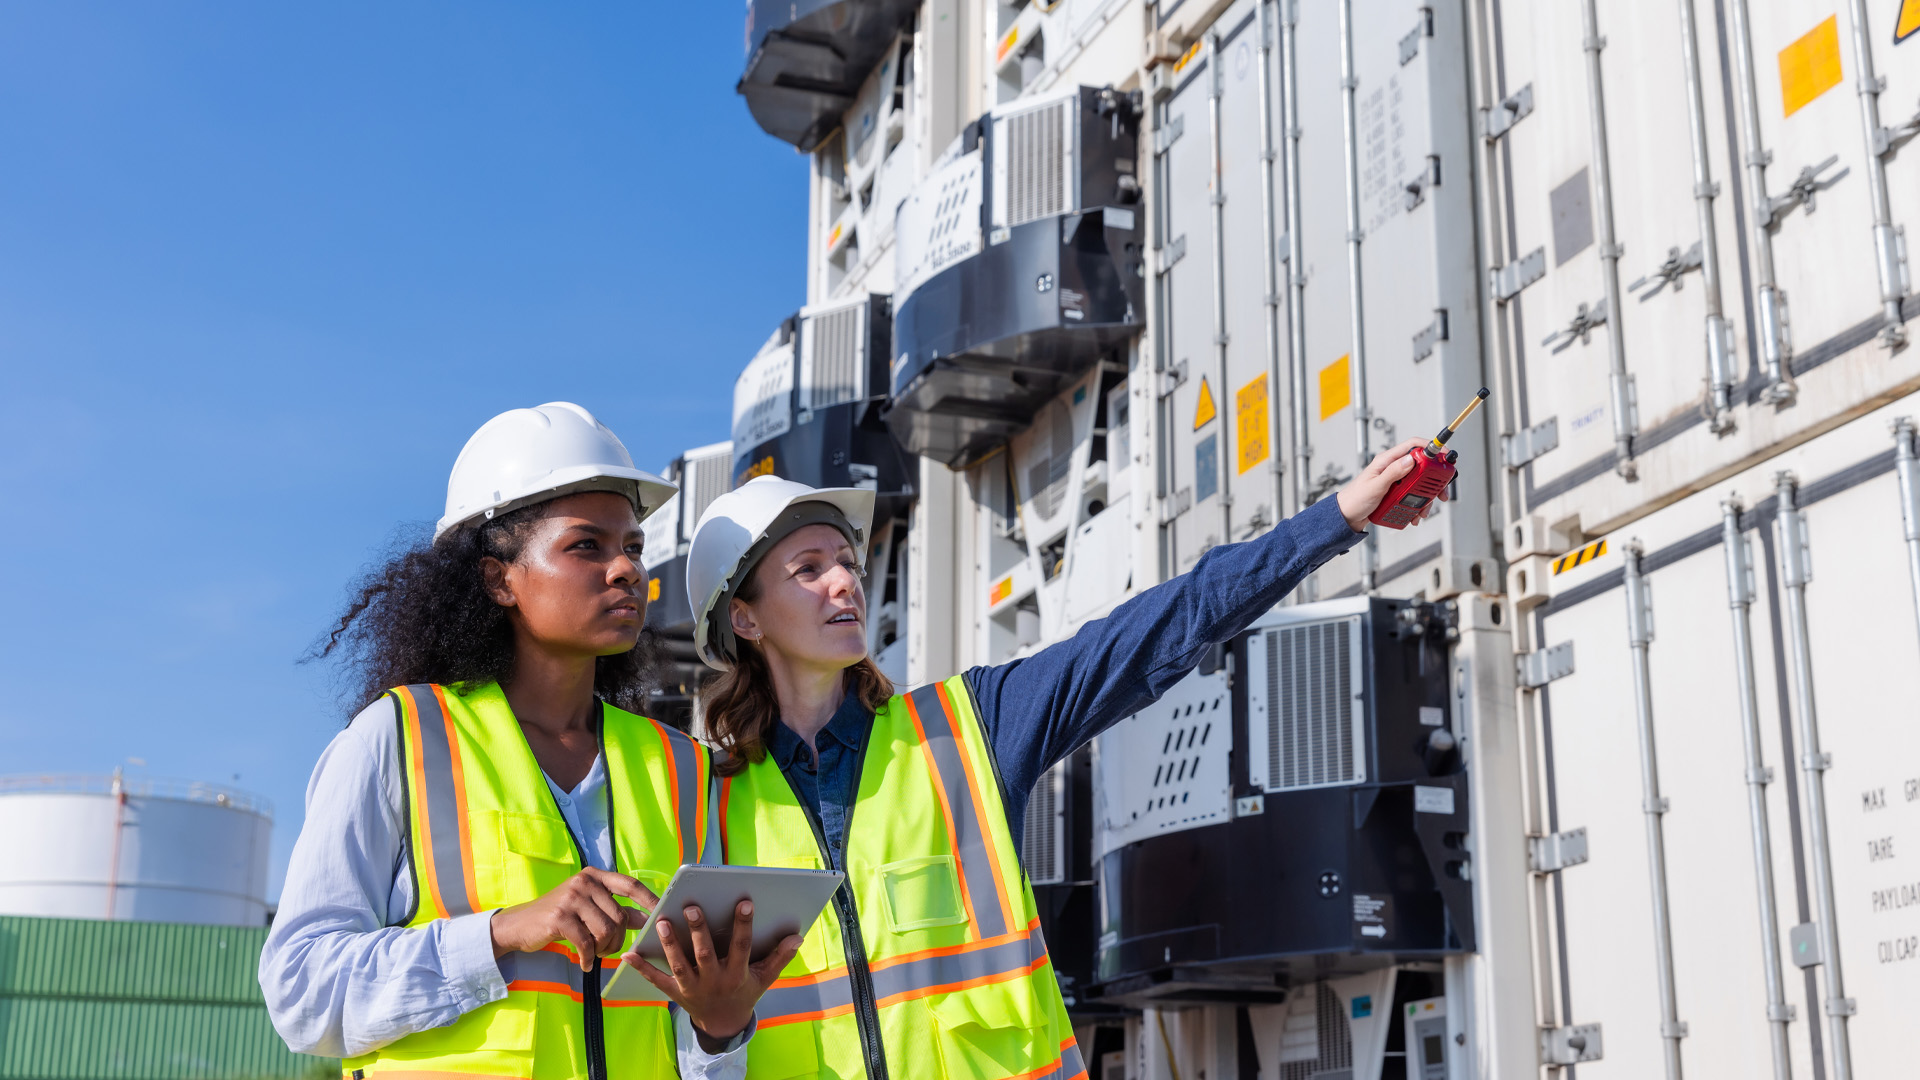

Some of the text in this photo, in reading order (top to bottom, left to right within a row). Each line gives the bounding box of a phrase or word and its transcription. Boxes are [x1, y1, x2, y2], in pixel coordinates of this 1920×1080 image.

[1862, 778, 1920, 813] MAX GR
[1867, 836, 1895, 863] TARE
[1872, 881, 1920, 912] PAYLOA
